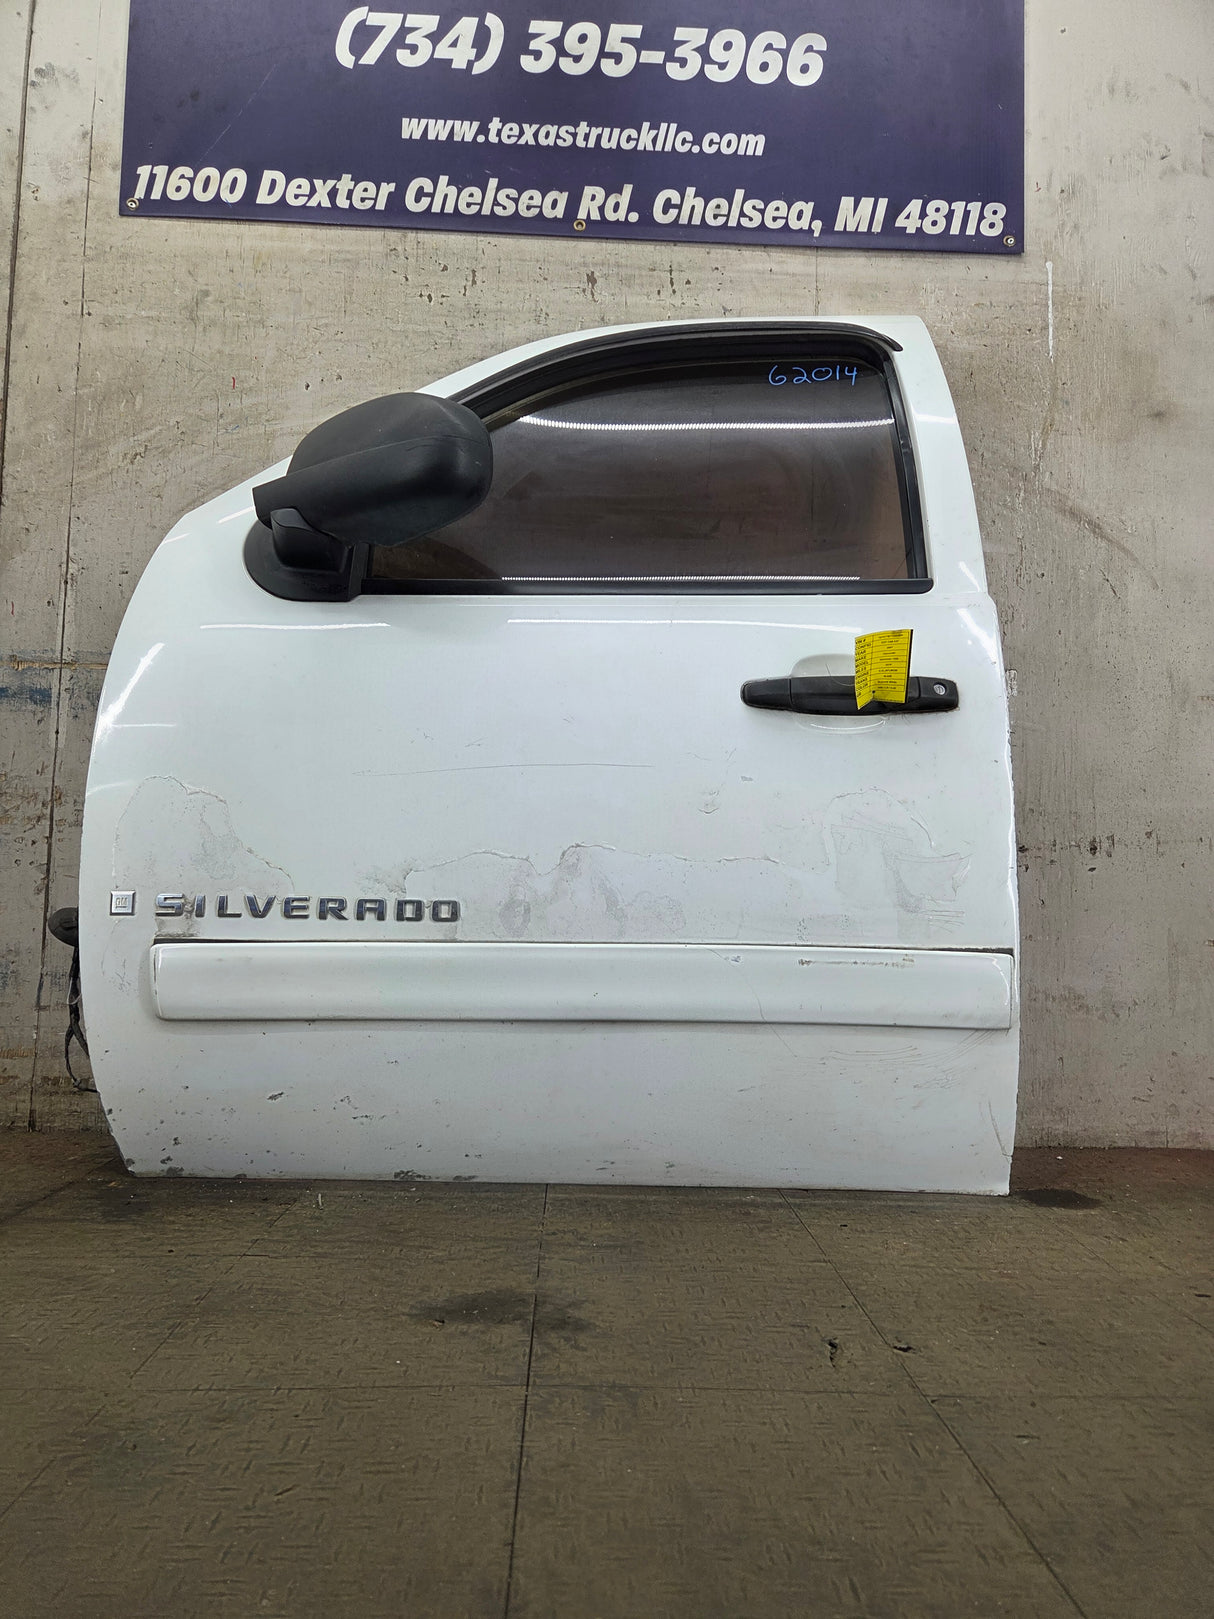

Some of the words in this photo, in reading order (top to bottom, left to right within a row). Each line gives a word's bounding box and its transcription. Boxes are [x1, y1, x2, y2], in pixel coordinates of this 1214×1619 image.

[334, 6, 504, 74] (734)
[519, 19, 828, 87] 395-3966
[401, 116, 766, 156] www.texastruckllc.com
[131, 164, 248, 205] 11600
[256, 169, 396, 211] Dexter
[405, 175, 569, 219] Chelsea
[576, 183, 639, 223] Rd.
[652, 186, 823, 238] Chelsea,
[834, 196, 889, 234] MI
[894, 198, 1007, 237] 48118
[768, 364, 858, 386] 62014
[155, 892, 462, 922] SILVERADO
